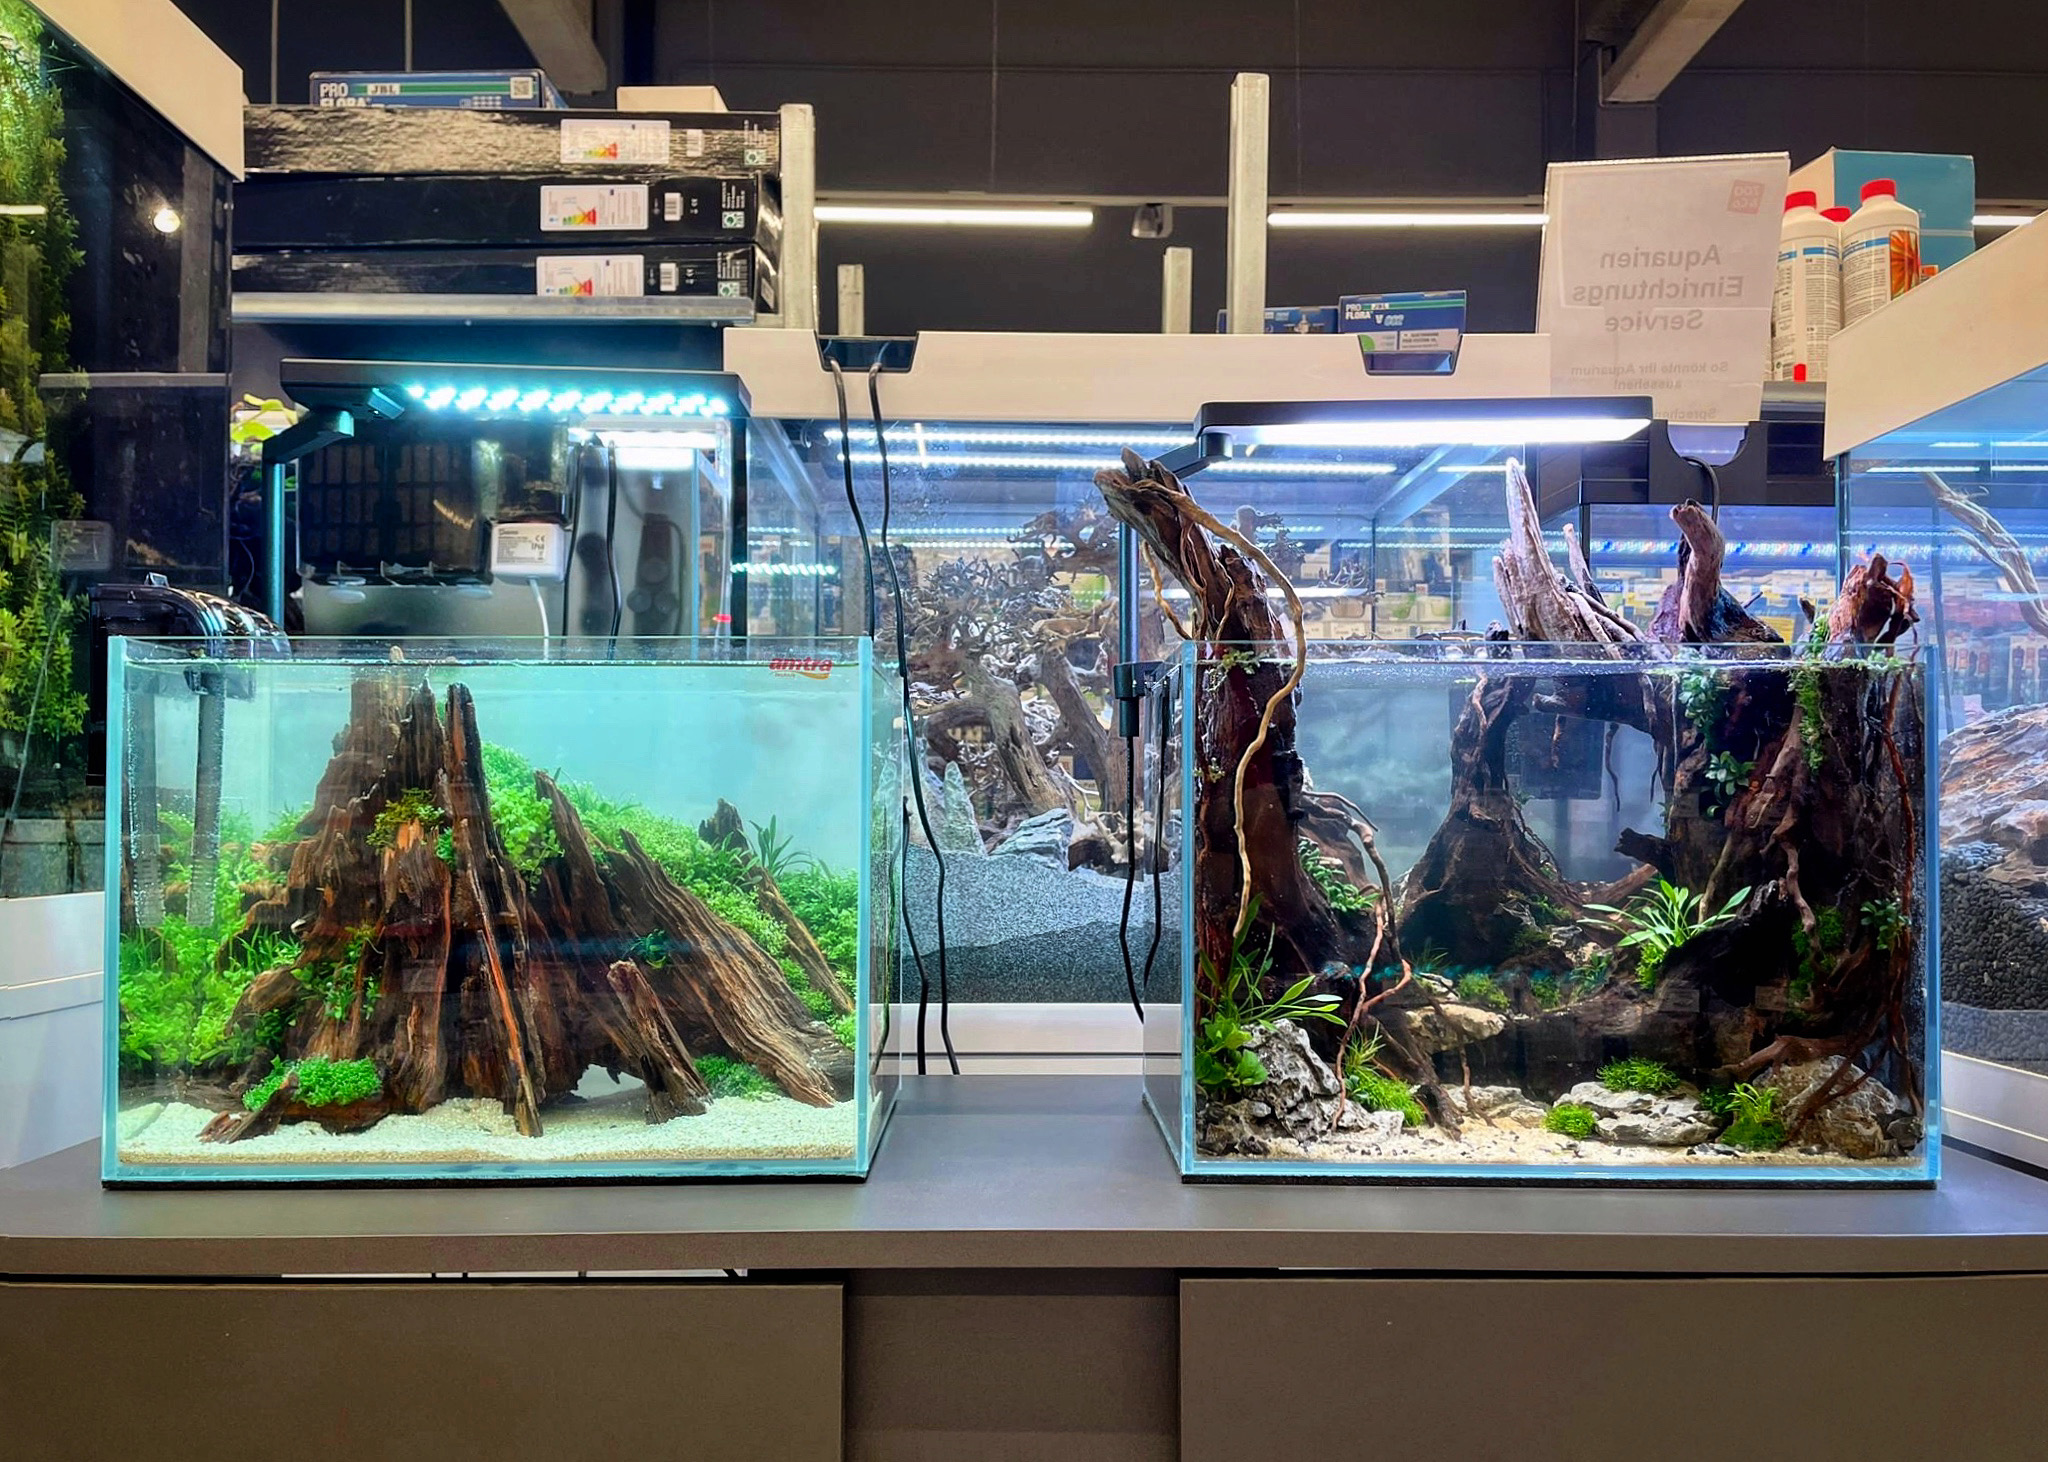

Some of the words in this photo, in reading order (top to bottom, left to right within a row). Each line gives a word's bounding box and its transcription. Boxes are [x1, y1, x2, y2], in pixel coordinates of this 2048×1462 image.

[320, 83, 349, 98] PRO
[370, 84, 397, 95] JBL
[1345, 303, 1362, 312] PRO
[1345, 311, 1371, 320] FLORA
